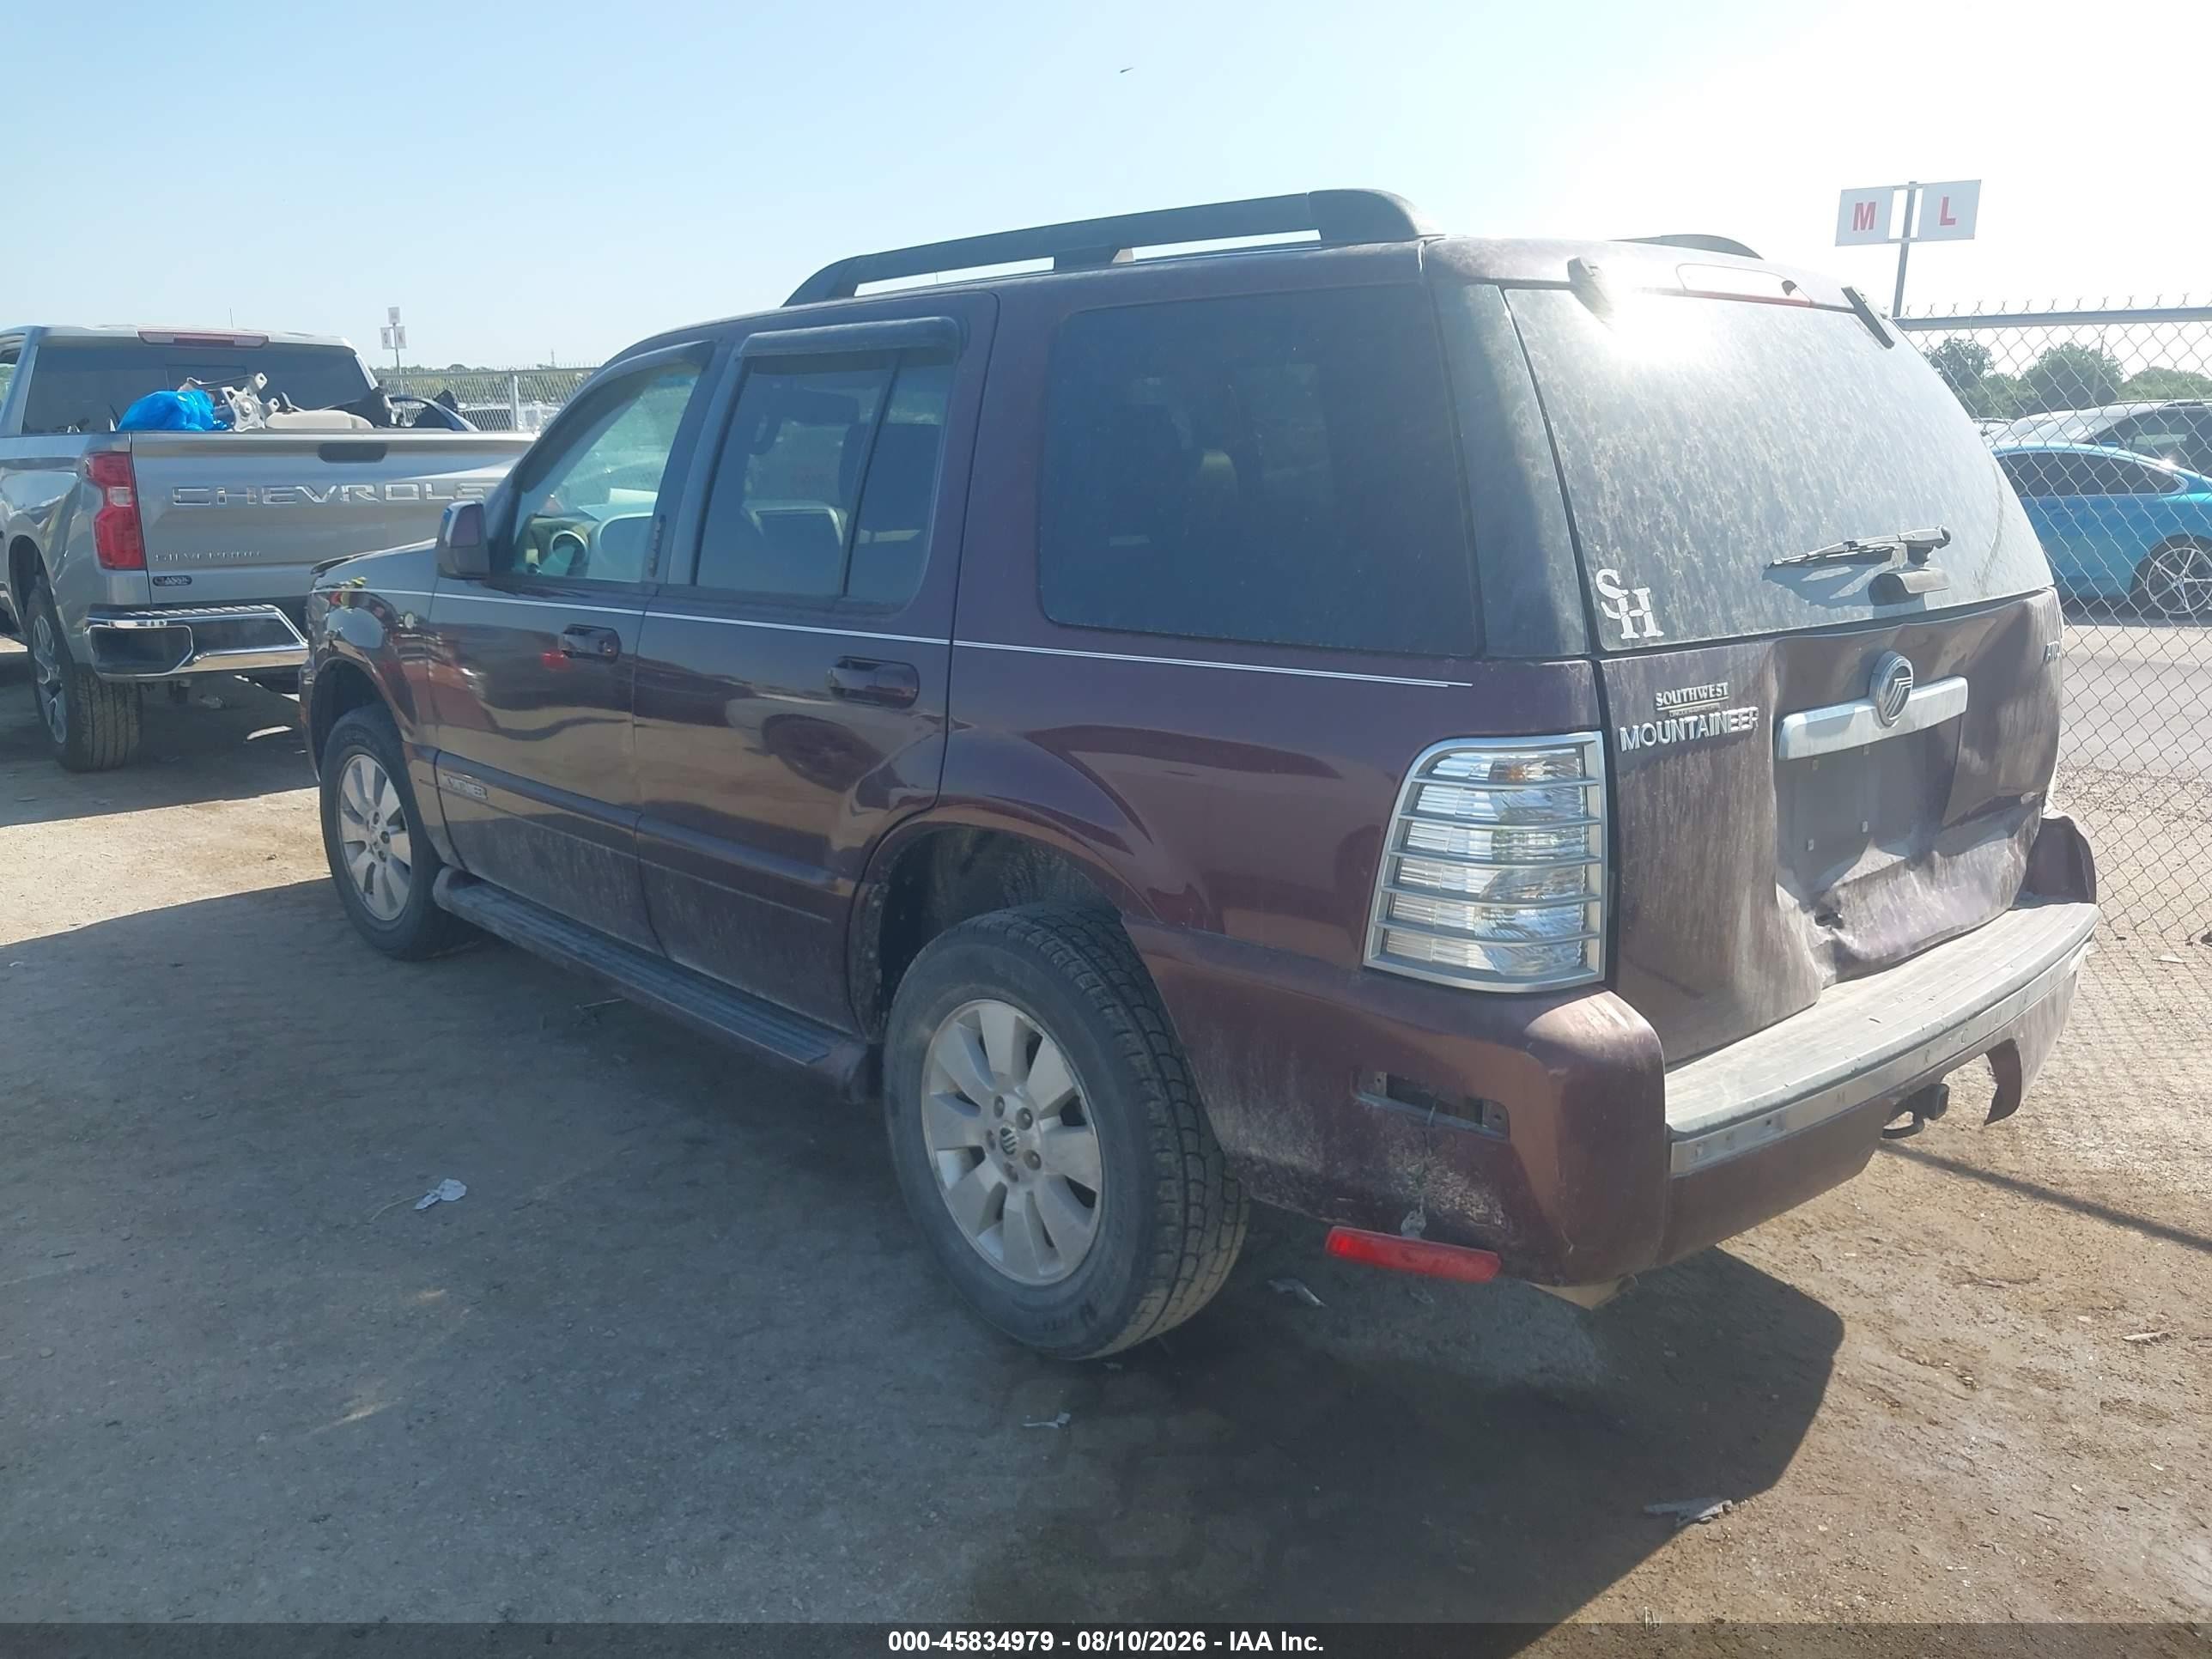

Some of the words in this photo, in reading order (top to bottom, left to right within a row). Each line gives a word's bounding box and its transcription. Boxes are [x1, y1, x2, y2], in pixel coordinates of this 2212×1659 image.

[1852, 201, 1877, 232] M
[1939, 196, 1957, 227] L
[172, 482, 499, 505] CHEVROLE
[1655, 682, 1729, 708] SOUTHWEST
[1620, 706, 1759, 752] MOUNTAINEER
